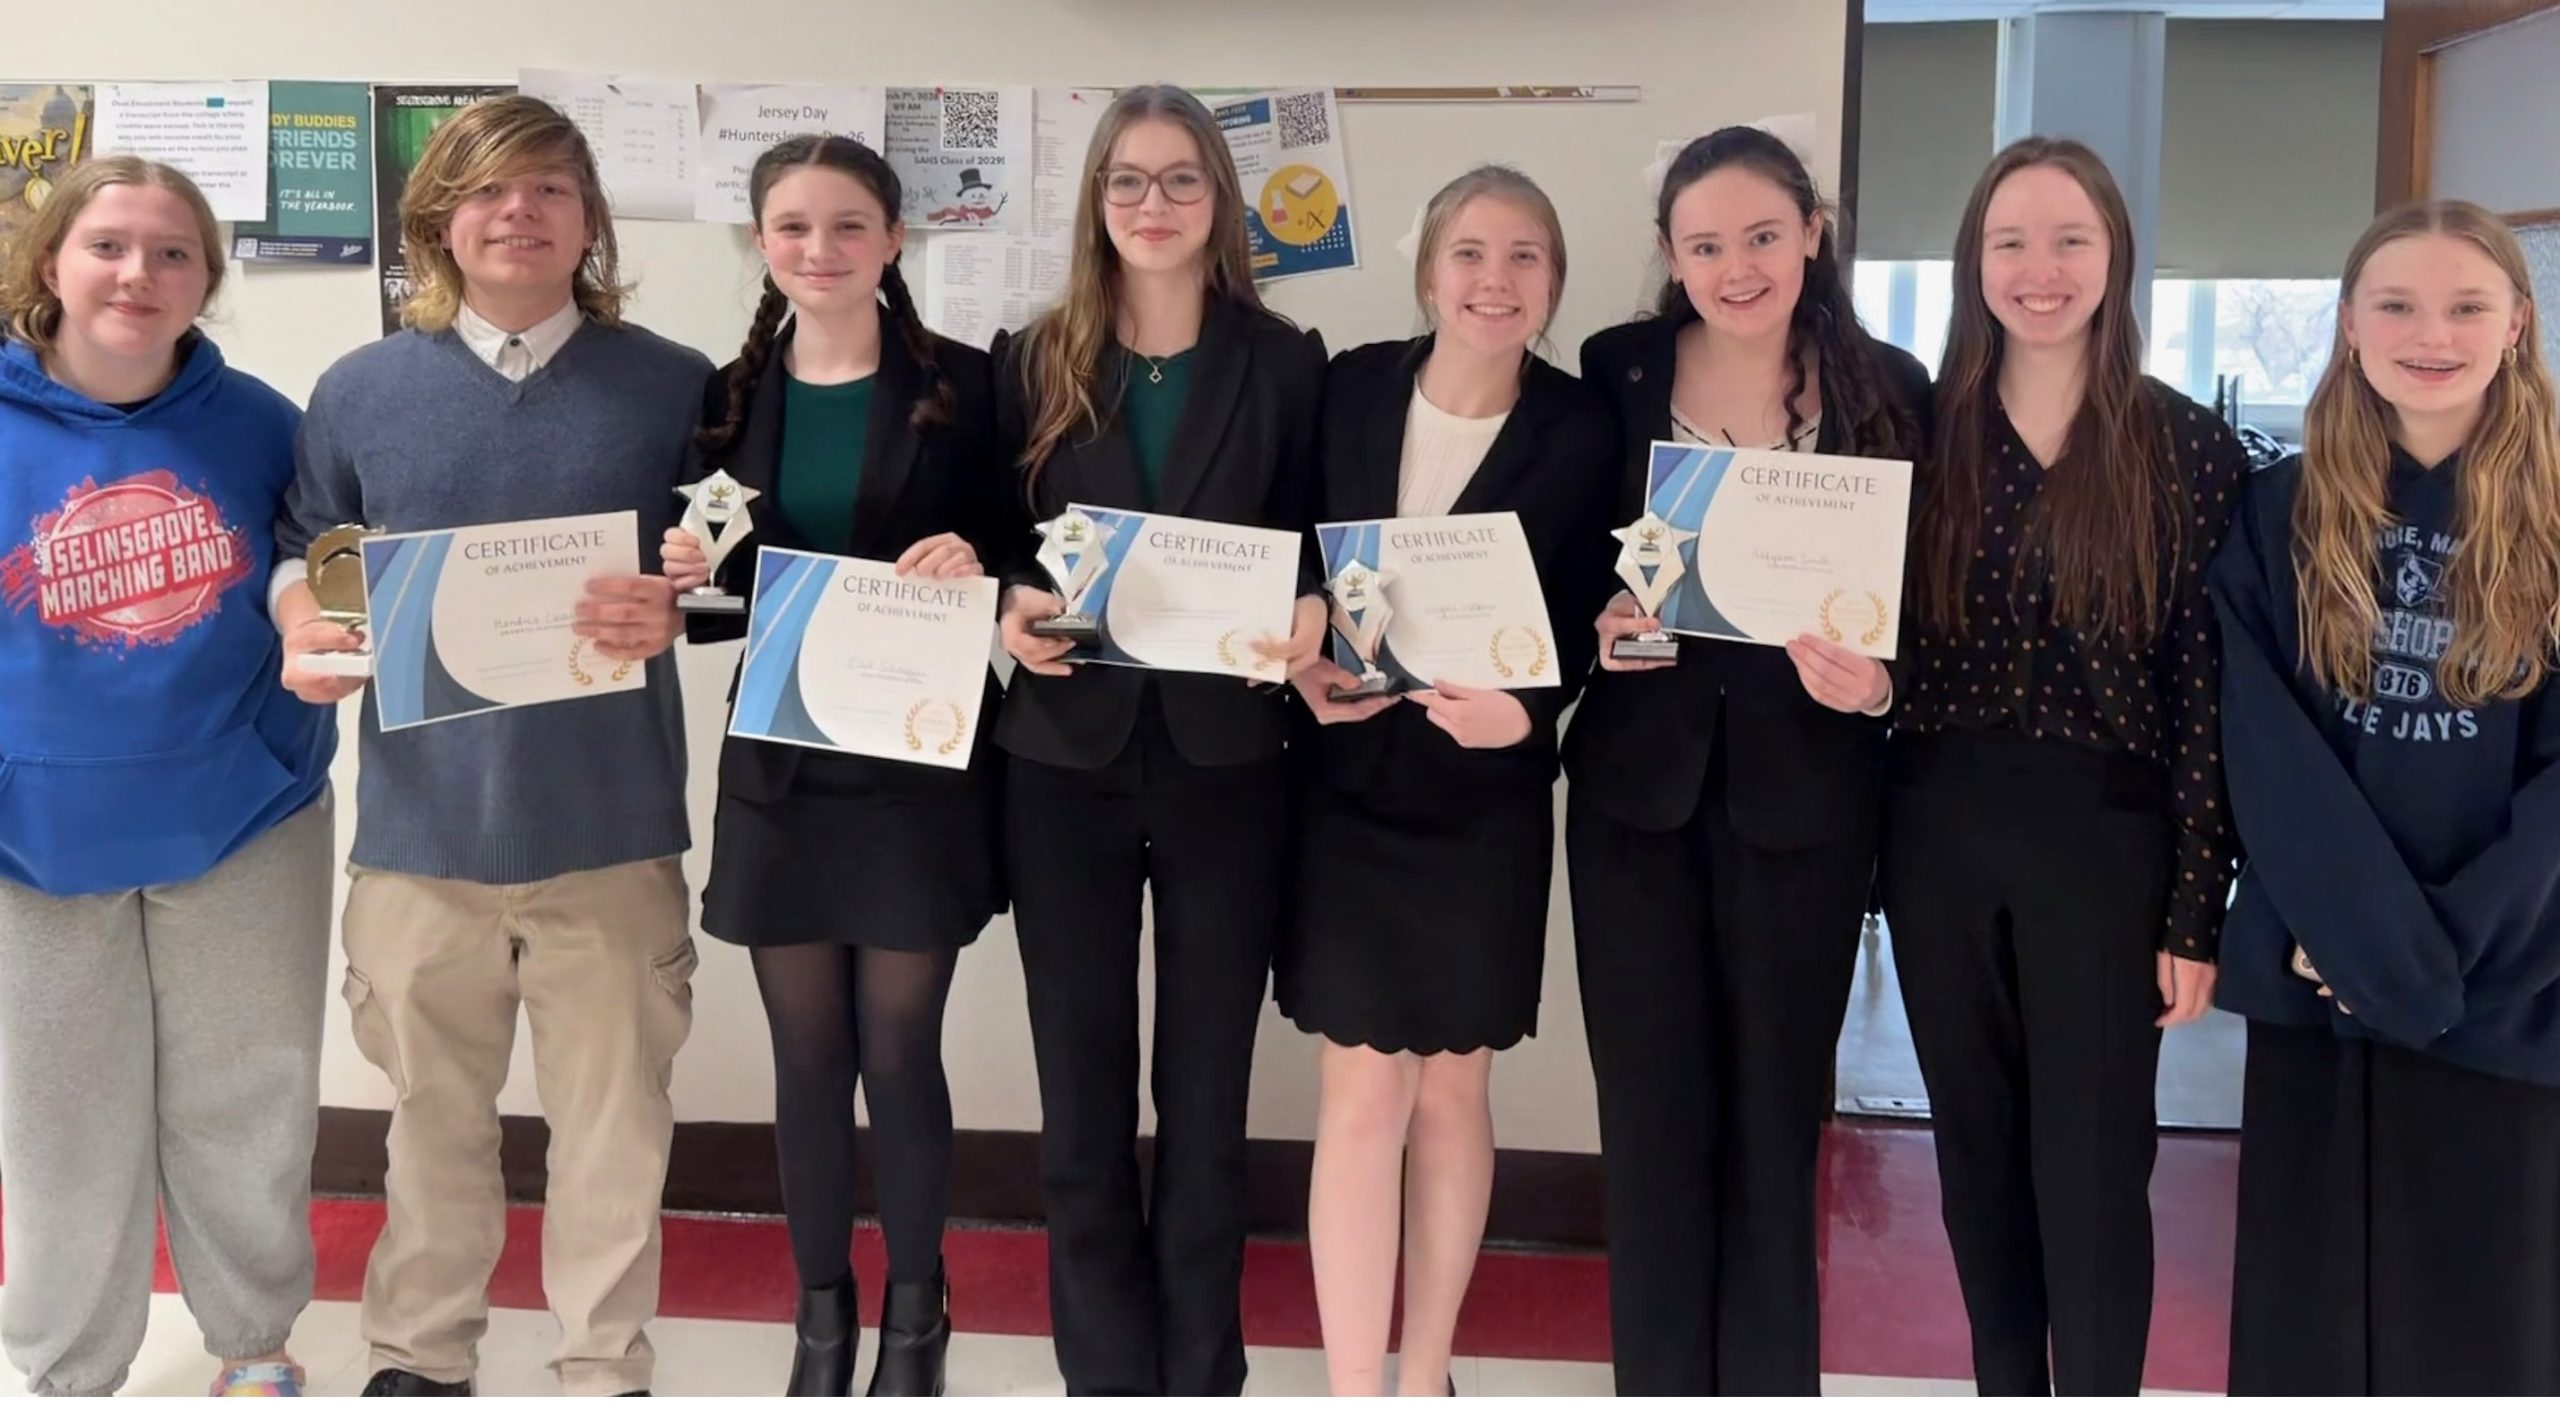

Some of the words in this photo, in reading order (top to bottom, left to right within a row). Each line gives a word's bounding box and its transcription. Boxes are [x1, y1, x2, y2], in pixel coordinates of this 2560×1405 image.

[294, 114, 357, 129] BUDDIES
[757, 105, 799, 121] Jersey
[803, 105, 828, 121] Day
[940, 156, 963, 165] Class
[965, 156, 975, 165] of
[280, 200, 300, 210] THE
[1740, 466, 1877, 495] CERTIFICATE
[1756, 493, 1770, 503] OF
[1774, 495, 1856, 512] ACHIEVEMENT
[53, 505, 209, 577] SELINSGROVE
[464, 530, 605, 561] CERTIFICATE
[1150, 531, 1271, 560] CERTIFICATE
[1391, 528, 1498, 550] CERTIFICATE
[485, 565, 501, 576] OF
[503, 555, 587, 573] ACHIEVEMENT
[40, 554, 165, 620] MARCHING
[170, 535, 233, 584] BAND
[843, 575, 968, 608] CERTIFICATE
[857, 602, 871, 613] OF
[873, 604, 947, 623] ACHIEVEMENT
[2392, 709, 2479, 741] JAYS
